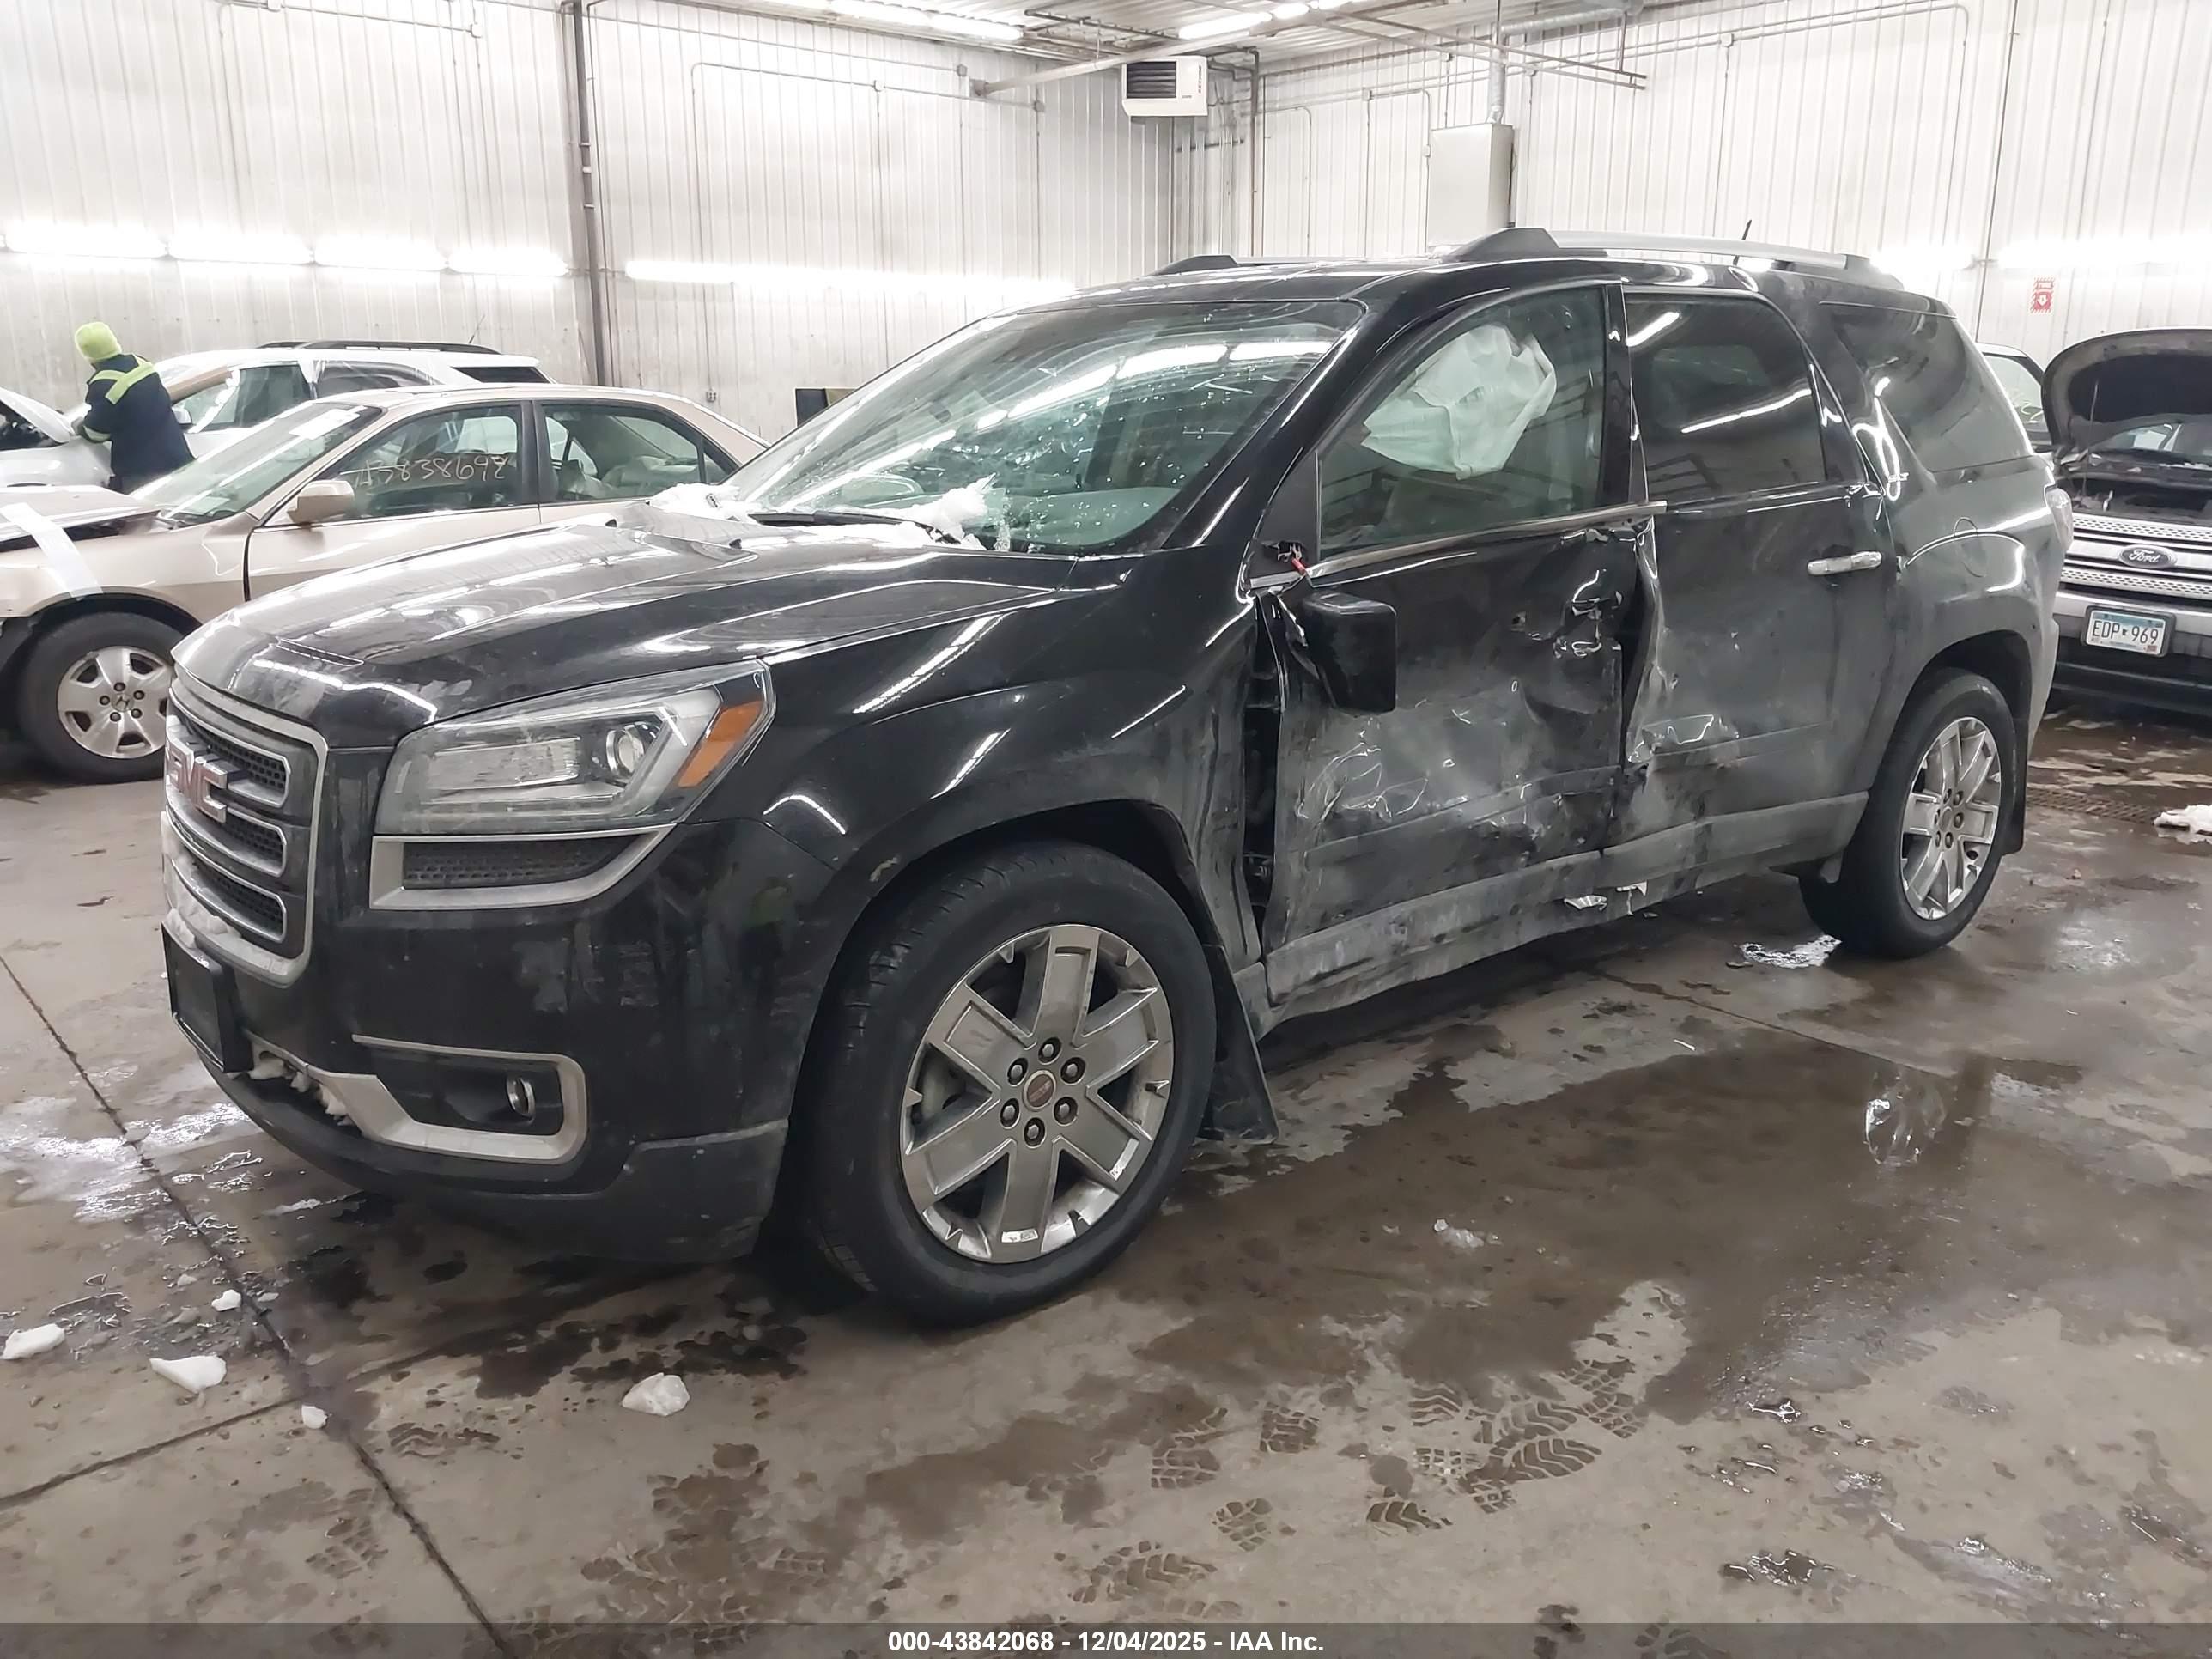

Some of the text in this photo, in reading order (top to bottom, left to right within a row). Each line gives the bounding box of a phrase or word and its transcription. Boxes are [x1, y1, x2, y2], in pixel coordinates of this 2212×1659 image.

[2129, 549, 2160, 564] Ford
[2093, 621, 2159, 645] EDP 969
